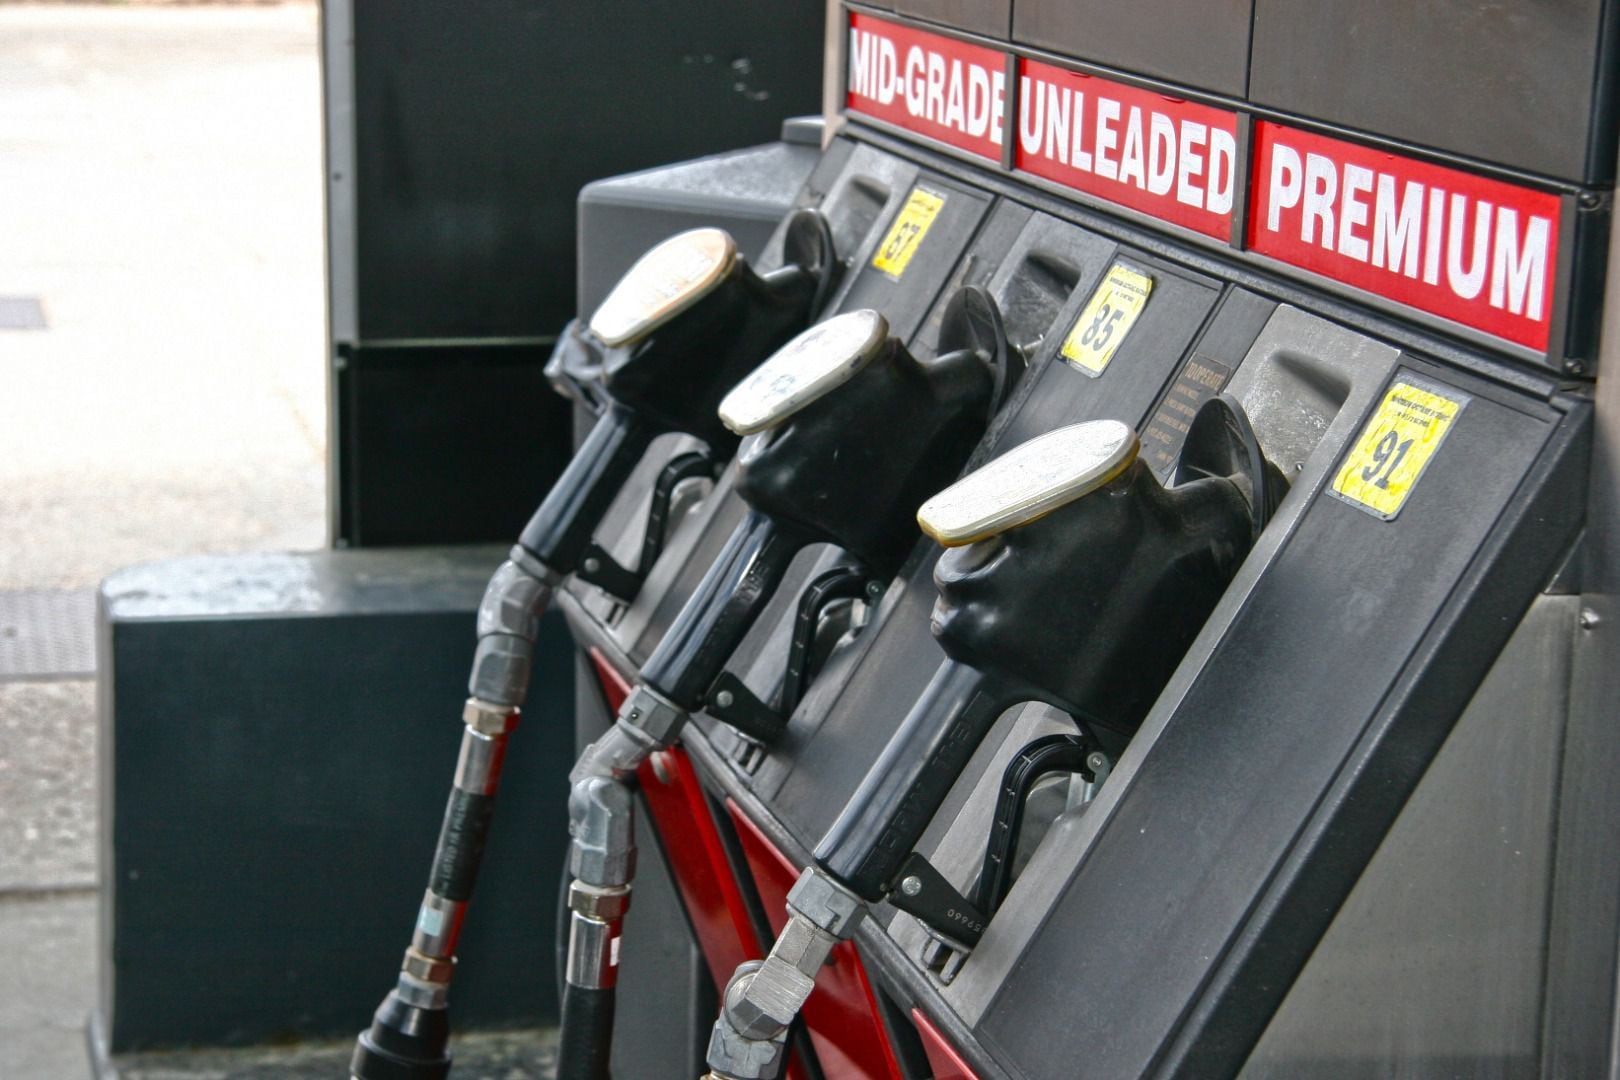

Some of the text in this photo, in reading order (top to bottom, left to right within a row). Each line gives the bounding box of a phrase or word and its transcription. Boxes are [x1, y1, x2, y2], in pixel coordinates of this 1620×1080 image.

[849, 28, 1005, 145] MID-GRADE
[1019, 76, 1236, 215] UNLEADED
[885, 222, 920, 261] 87
[1267, 143, 1550, 321] PREMIUM
[1081, 303, 1124, 351] 85
[1361, 430, 1414, 490] 91
